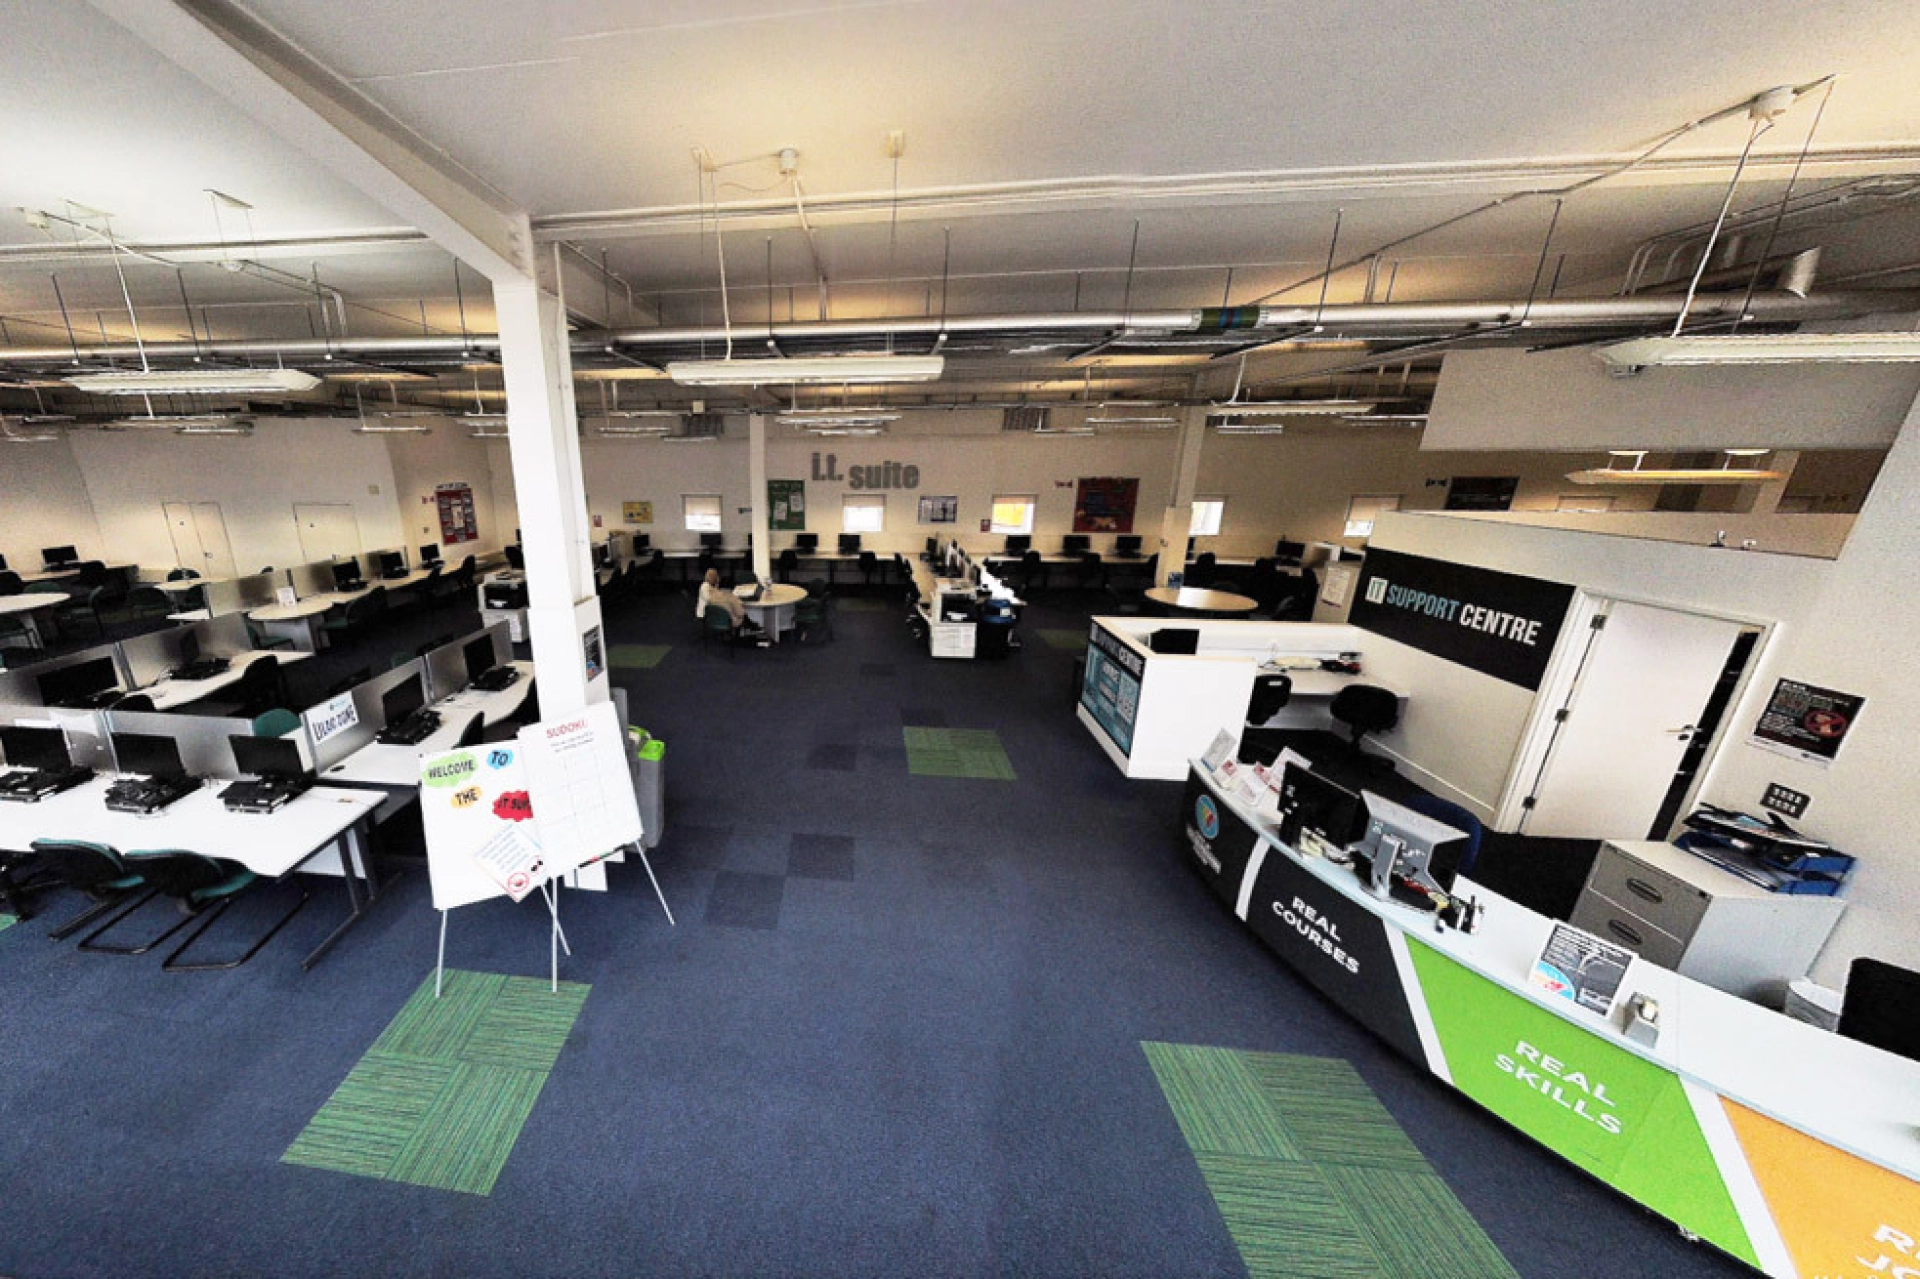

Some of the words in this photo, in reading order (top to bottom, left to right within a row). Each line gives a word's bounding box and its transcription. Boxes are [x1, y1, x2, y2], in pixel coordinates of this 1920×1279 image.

[849, 460, 920, 490] suite
[1387, 583, 1460, 622] SUPPORT
[1459, 603, 1543, 646] CENTRE
[428, 759, 476, 780] WELCOME
[491, 751, 510, 767] TO
[455, 787, 479, 807] THE
[1272, 901, 1361, 975] COURSES
[1292, 896, 1342, 942] REAL
[1494, 1053, 1623, 1135] SKILLS
[1515, 1039, 1617, 1109] REAL
